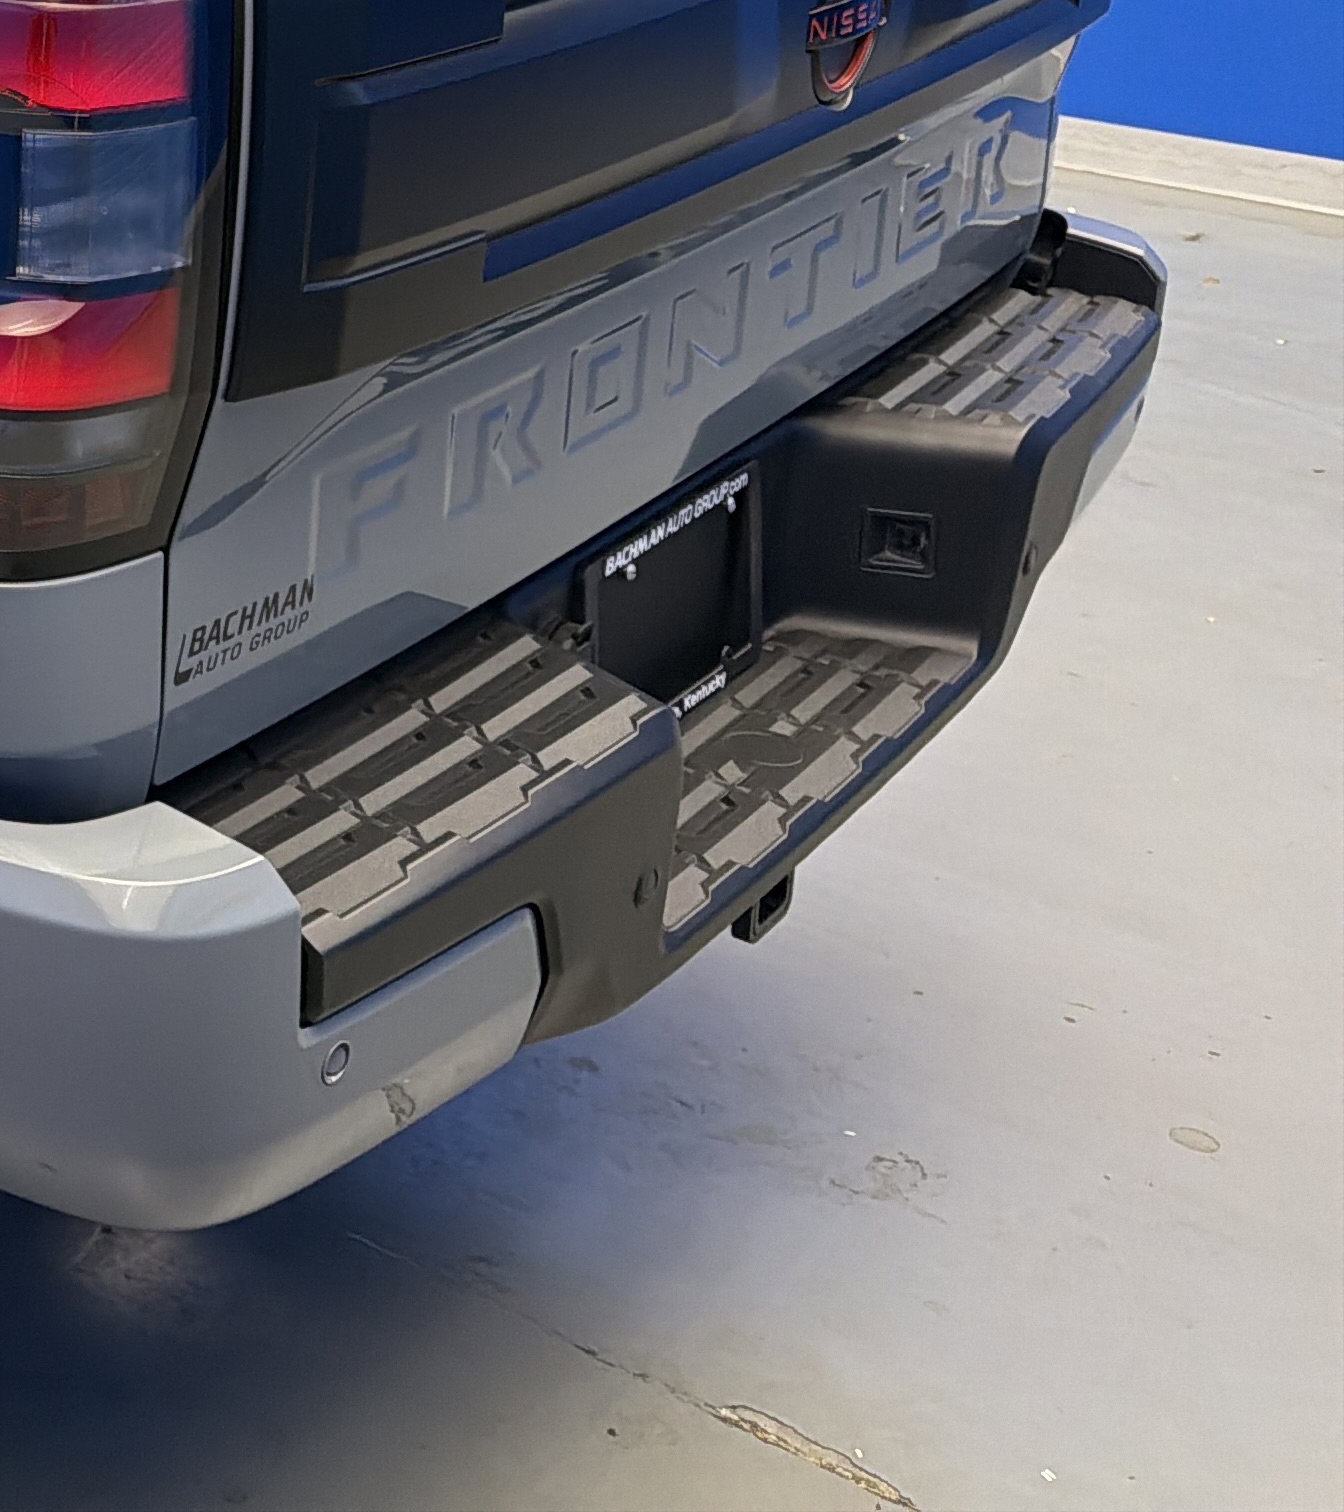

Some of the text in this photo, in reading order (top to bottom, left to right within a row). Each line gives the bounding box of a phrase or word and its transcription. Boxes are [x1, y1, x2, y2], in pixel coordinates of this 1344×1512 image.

[310, 104, 1014, 582] FRONTIER
[604, 522, 666, 578] BACHMAN
[665, 503, 694, 538] AUTO
[187, 573, 315, 659] BACHMAN
[192, 609, 310, 680] AUTO GROUP
